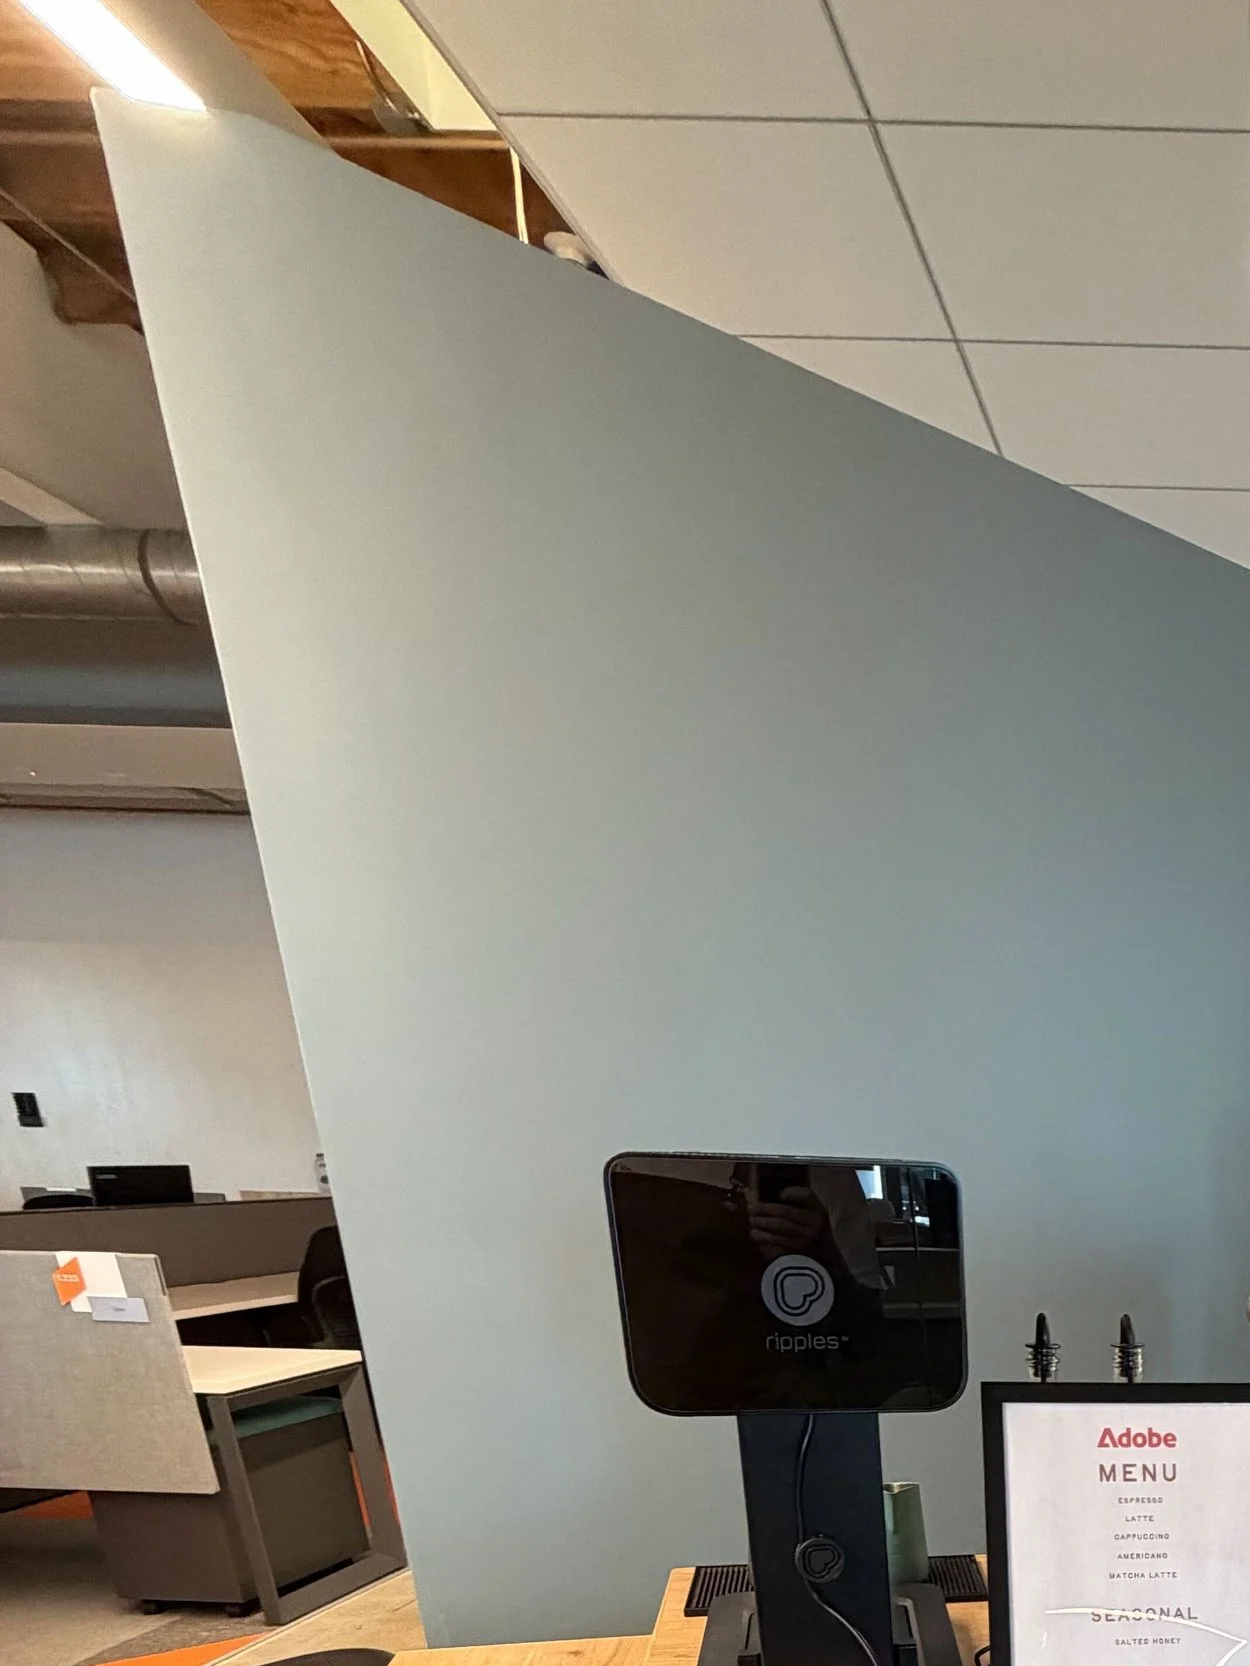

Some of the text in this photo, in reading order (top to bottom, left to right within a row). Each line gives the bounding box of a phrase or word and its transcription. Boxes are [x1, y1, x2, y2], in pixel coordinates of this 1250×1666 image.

[765, 1332, 840, 1353] ripples
[1097, 1427, 1177, 1448] Adobe
[1099, 1463, 1177, 1482] MENU
[1117, 1552, 1168, 1560] AMERICANO
[1149, 1571, 1178, 1579] LATTE
[1115, 1637, 1180, 1646] SALTED HONEY
